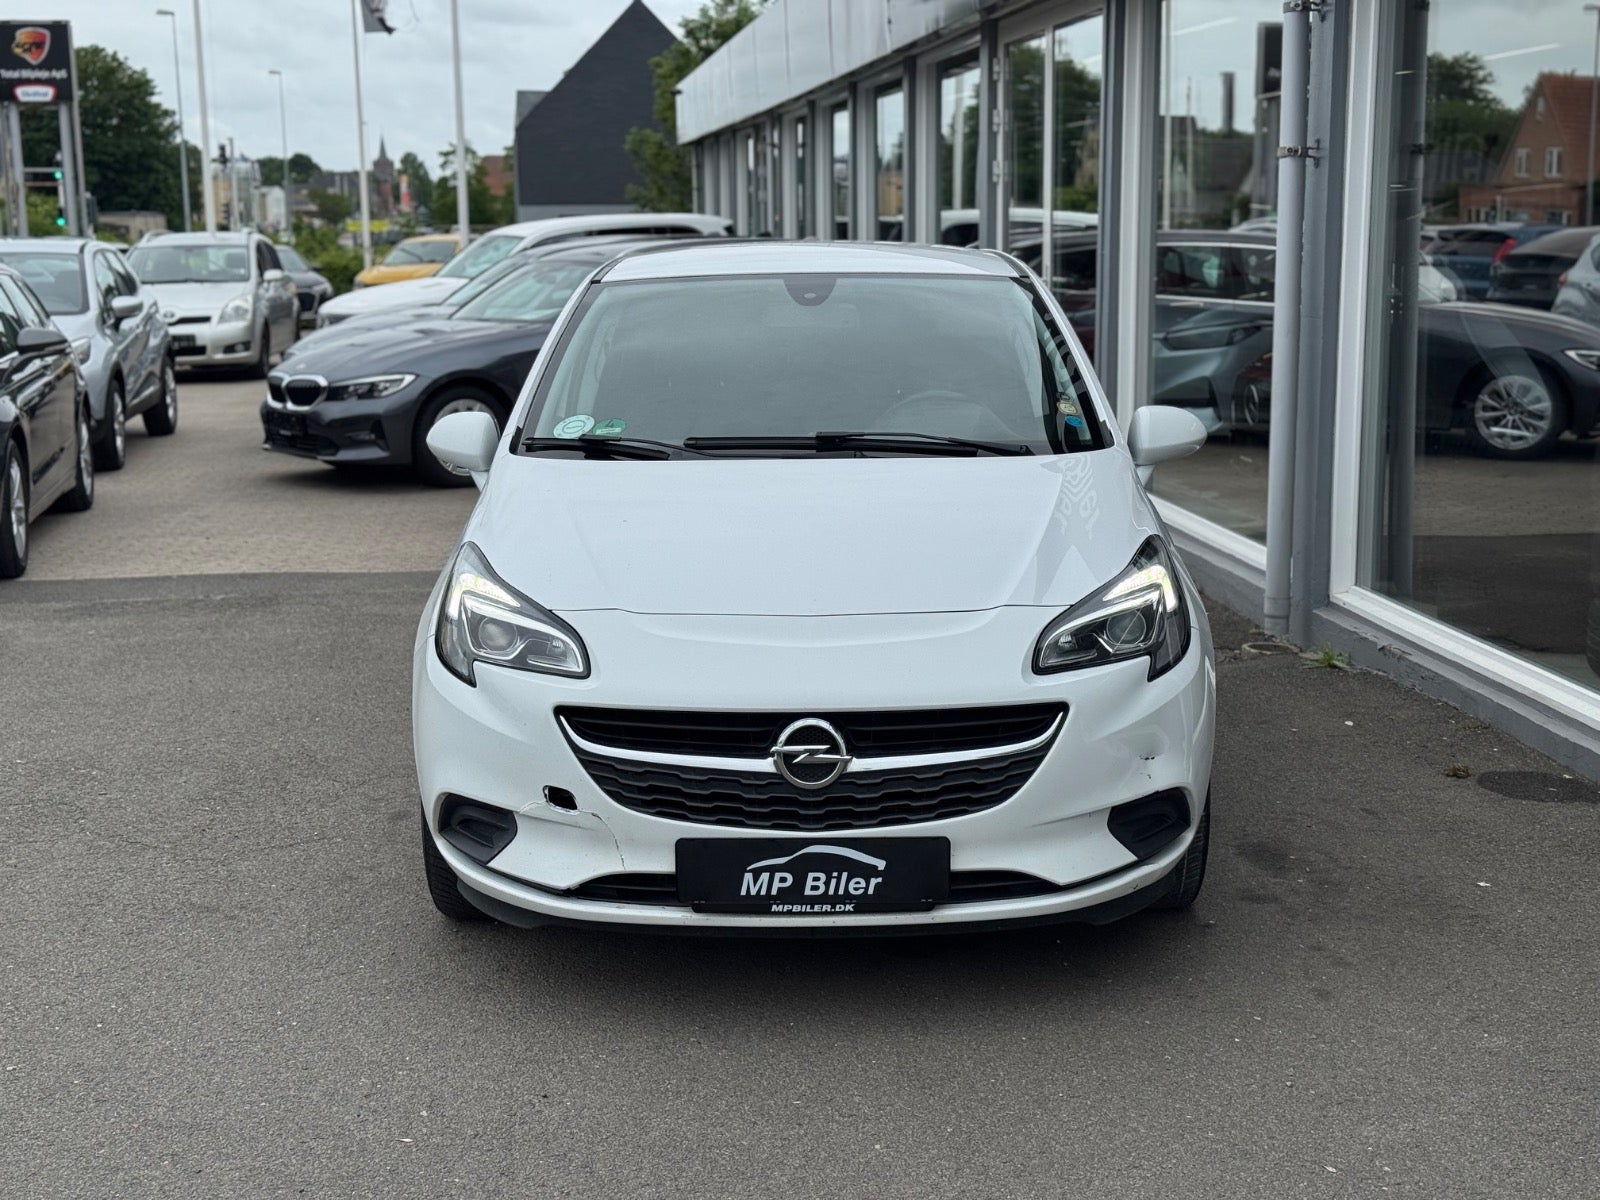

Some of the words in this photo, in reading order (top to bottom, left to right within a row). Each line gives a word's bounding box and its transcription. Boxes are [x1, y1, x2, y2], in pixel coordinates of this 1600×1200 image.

[740, 872, 793, 896] MP
[804, 871, 882, 896] Biler
[771, 904, 855, 912] MPBILER.DK
